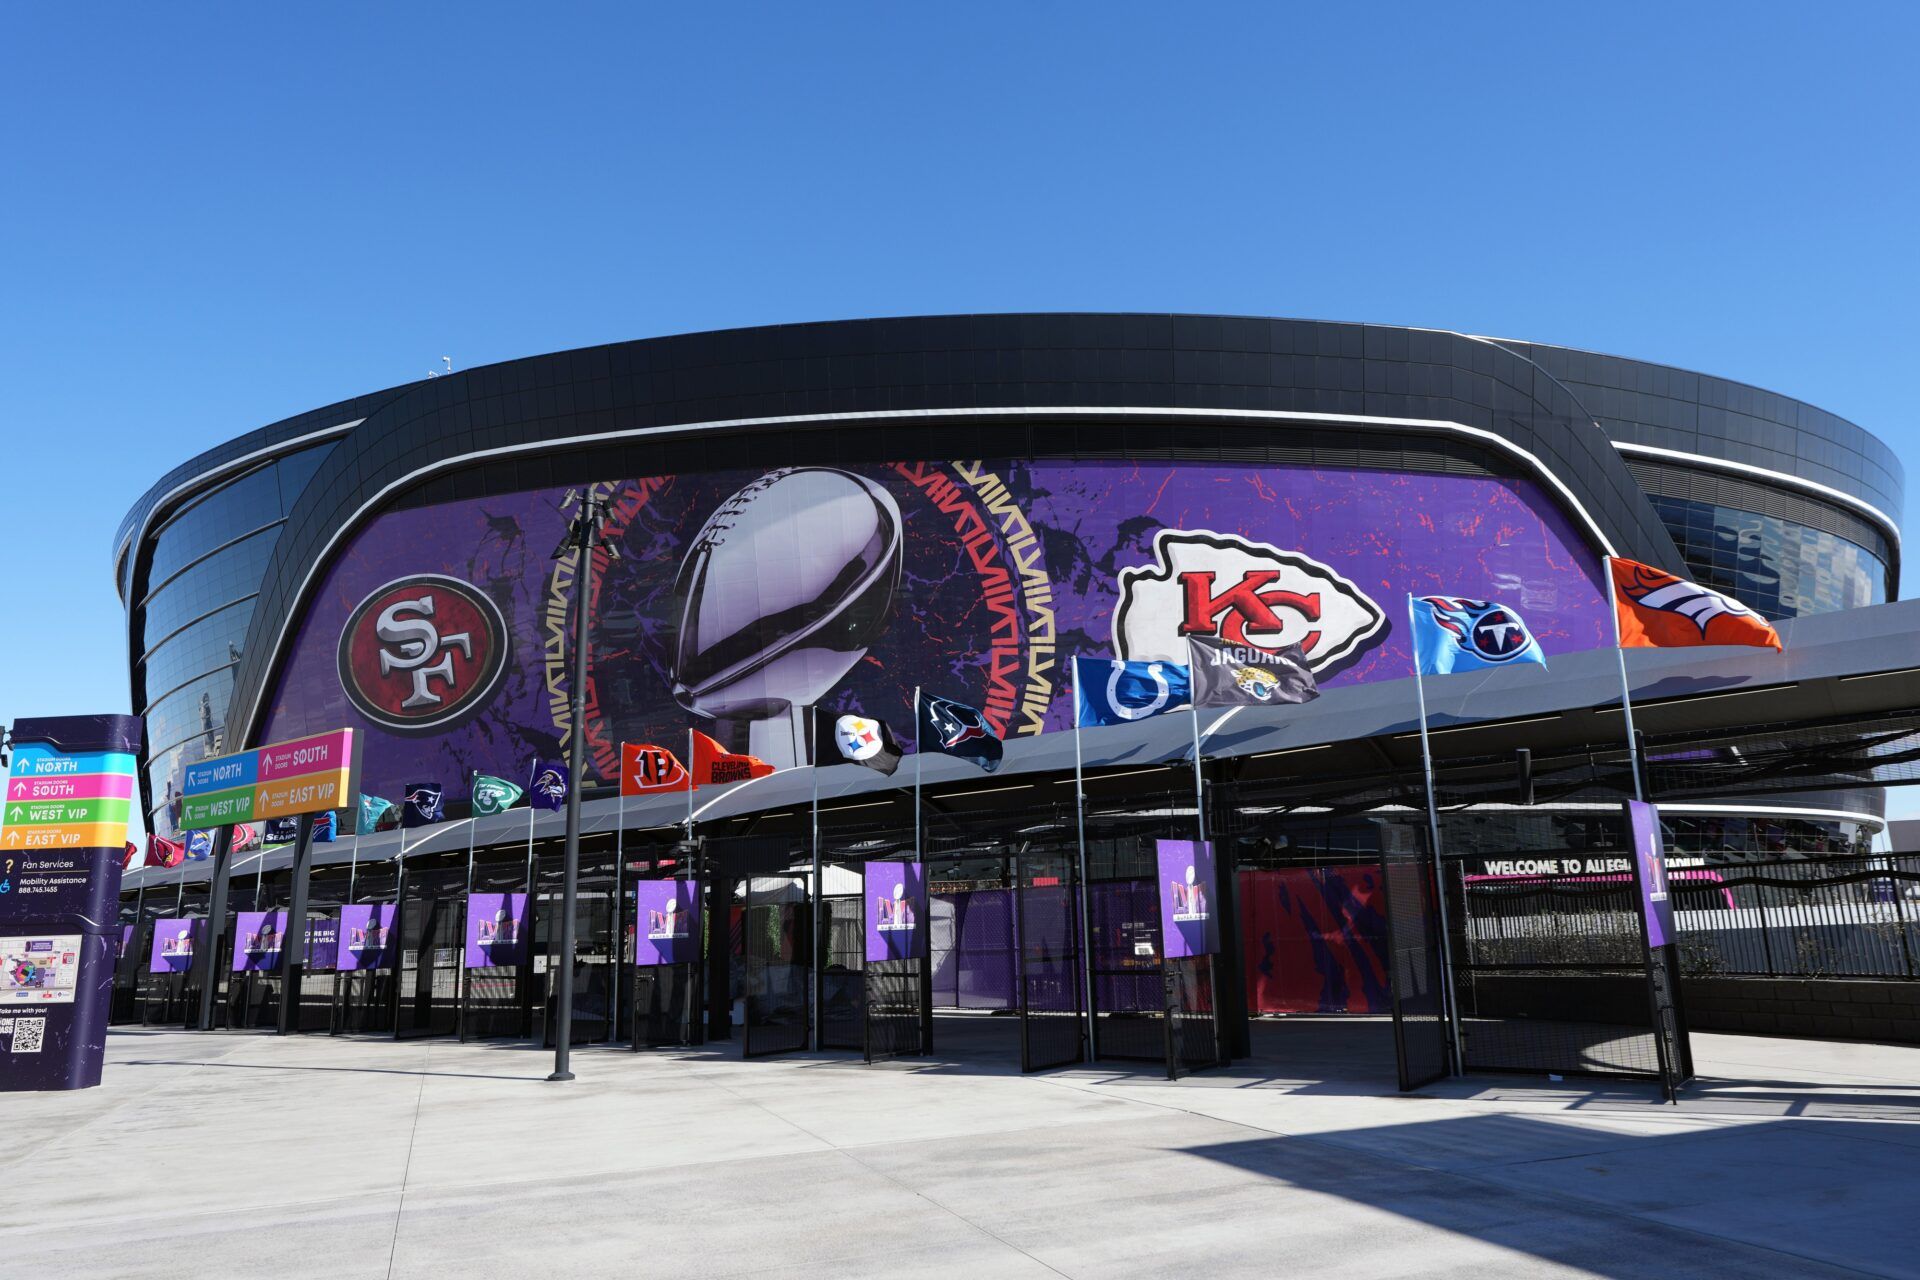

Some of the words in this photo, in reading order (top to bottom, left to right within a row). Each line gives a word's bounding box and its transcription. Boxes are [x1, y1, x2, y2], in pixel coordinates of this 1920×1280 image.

[1178, 570, 1322, 656] KC
[376, 595, 472, 708] SF
[293, 744, 328, 767] SOUTH
[35, 761, 78, 773] NORTH
[213, 762, 242, 782] NORTH
[711, 767, 752, 783] BROWNS
[32, 785, 74, 796] SOUTH
[289, 785, 315, 804] EAST
[317, 783, 335, 800] VIP
[29, 809, 63, 820] WEST
[68, 808, 88, 819] VIP
[210, 799, 234, 816] WEST
[236, 796, 250, 812] VIP
[25, 834, 57, 845] EAST
[61, 834, 81, 844] VIP
[22, 861, 38, 869] Fan
[39, 860, 74, 869] Services
[1484, 860, 1558, 875] WELCOME
[1561, 859, 1581, 874] TO
[1585, 858, 1632, 873] ALLEGI
[1664, 857, 1704, 868] TADIUM
[0, 1026, 14, 1034] ASS
